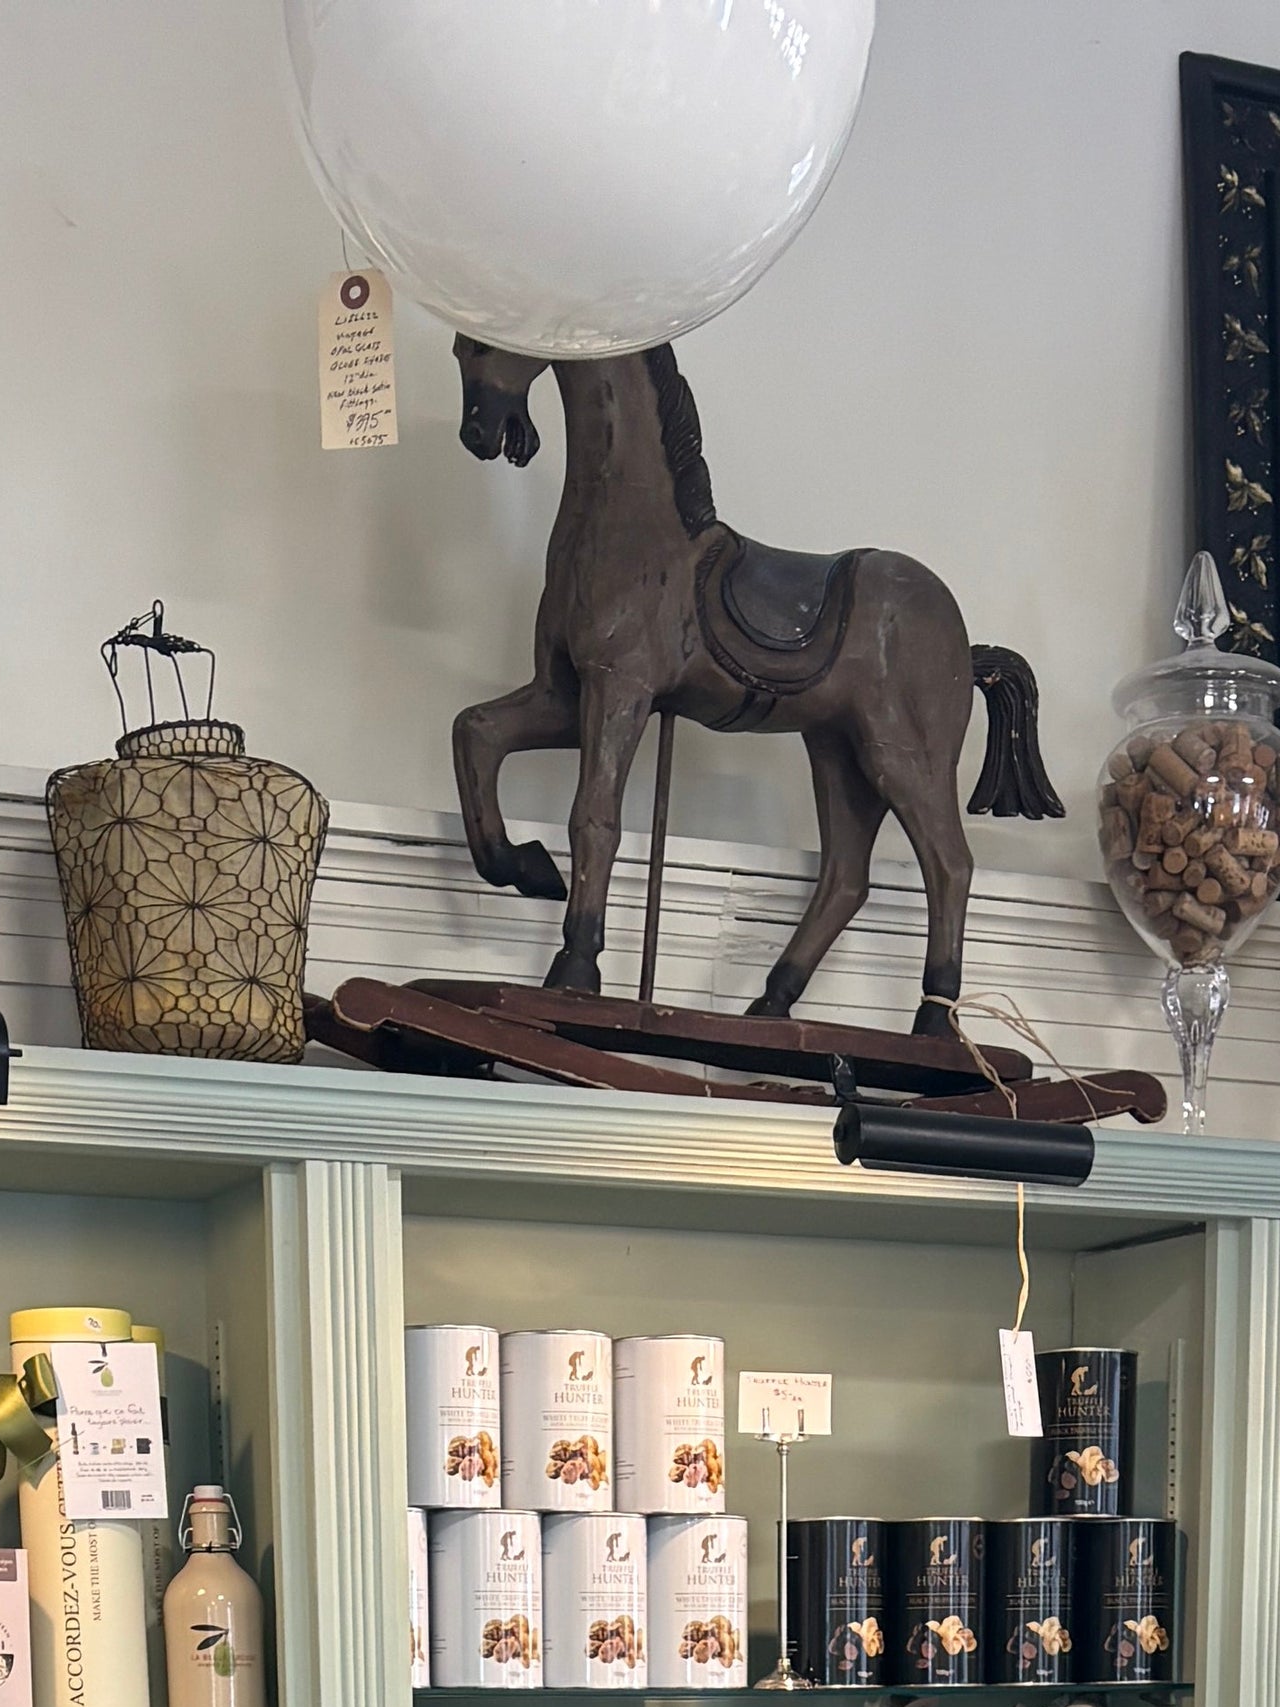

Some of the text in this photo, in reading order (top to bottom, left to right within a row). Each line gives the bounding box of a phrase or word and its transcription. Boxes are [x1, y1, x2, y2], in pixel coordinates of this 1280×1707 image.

[451, 1387, 496, 1400] HUNTER
[554, 1392, 604, 1405] HUNTER
[1057, 1406, 1111, 1418] HUNTER
[88, 1534, 102, 1621] MAKE THE MOST
[686, 1573, 737, 1586] HUNTER
[916, 1574, 969, 1588] HUNTER
[59, 1523, 85, 1707] ACCORDEZ-VOUS
